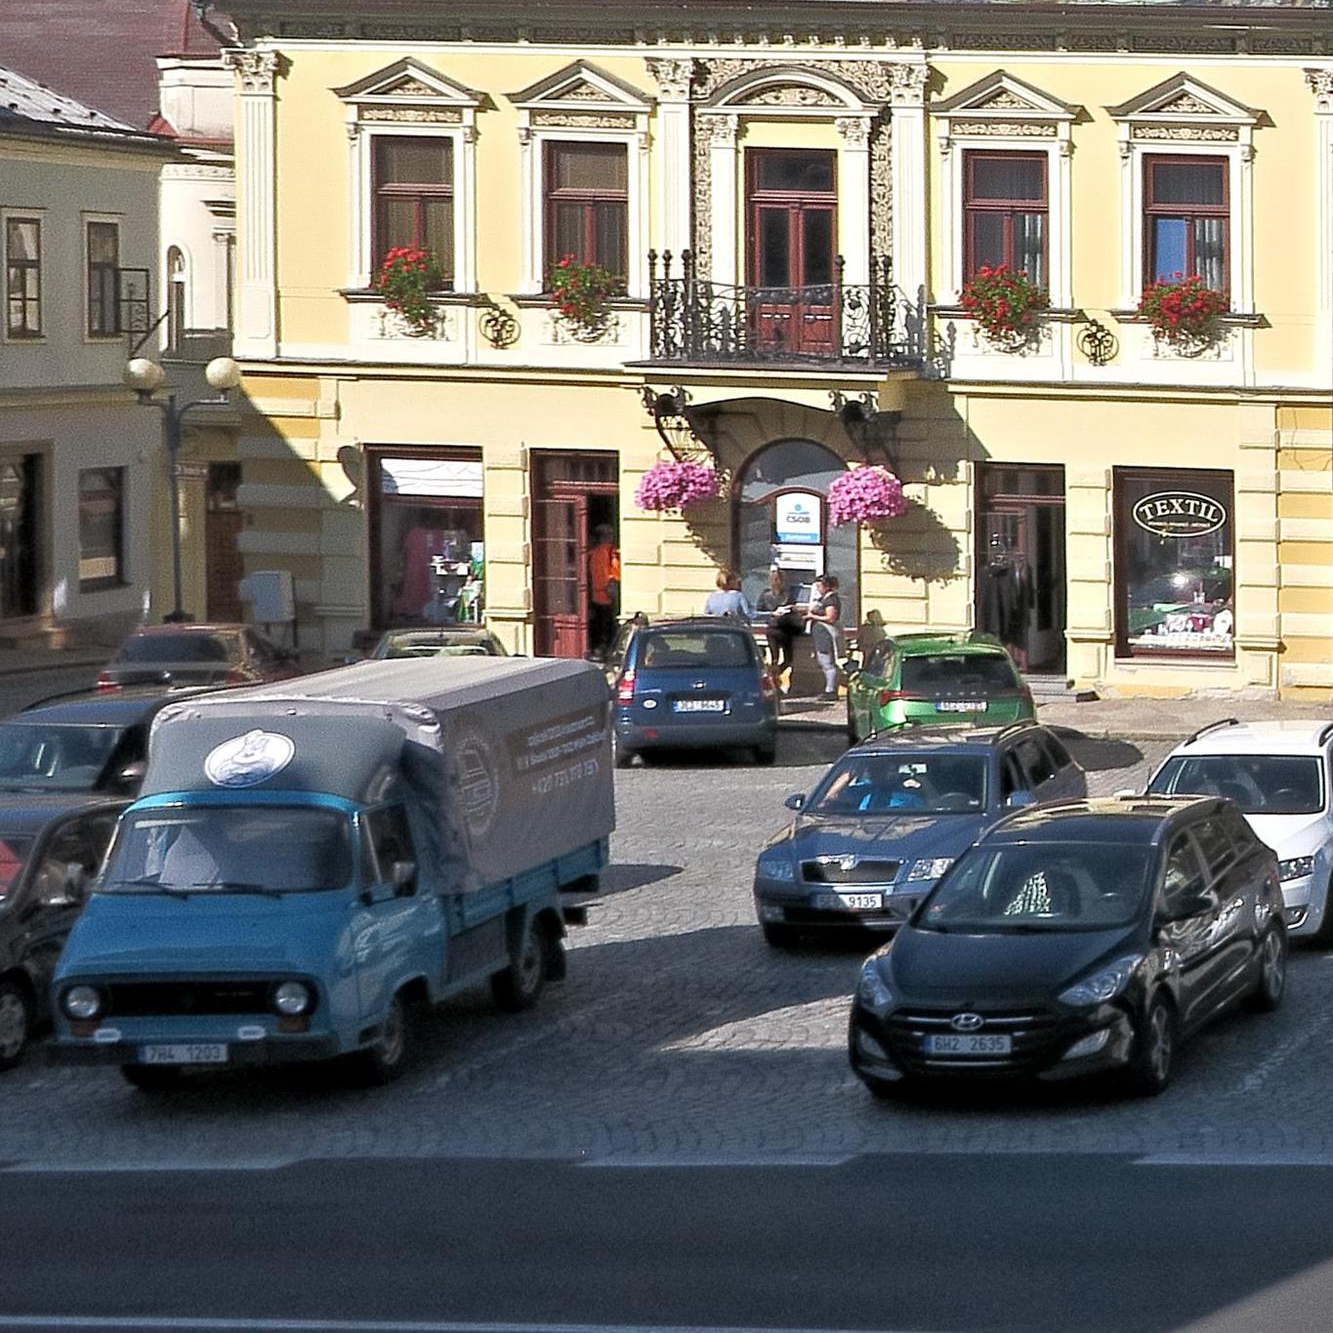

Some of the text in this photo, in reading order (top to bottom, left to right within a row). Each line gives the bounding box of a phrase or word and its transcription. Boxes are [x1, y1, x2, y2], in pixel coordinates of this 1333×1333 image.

[1139, 498, 1219, 522] TEXTIL
[849, 897, 876, 907] 9135
[934, 1037, 1005, 1050] 6H2 2635
[188, 1045, 221, 1059] 1203
